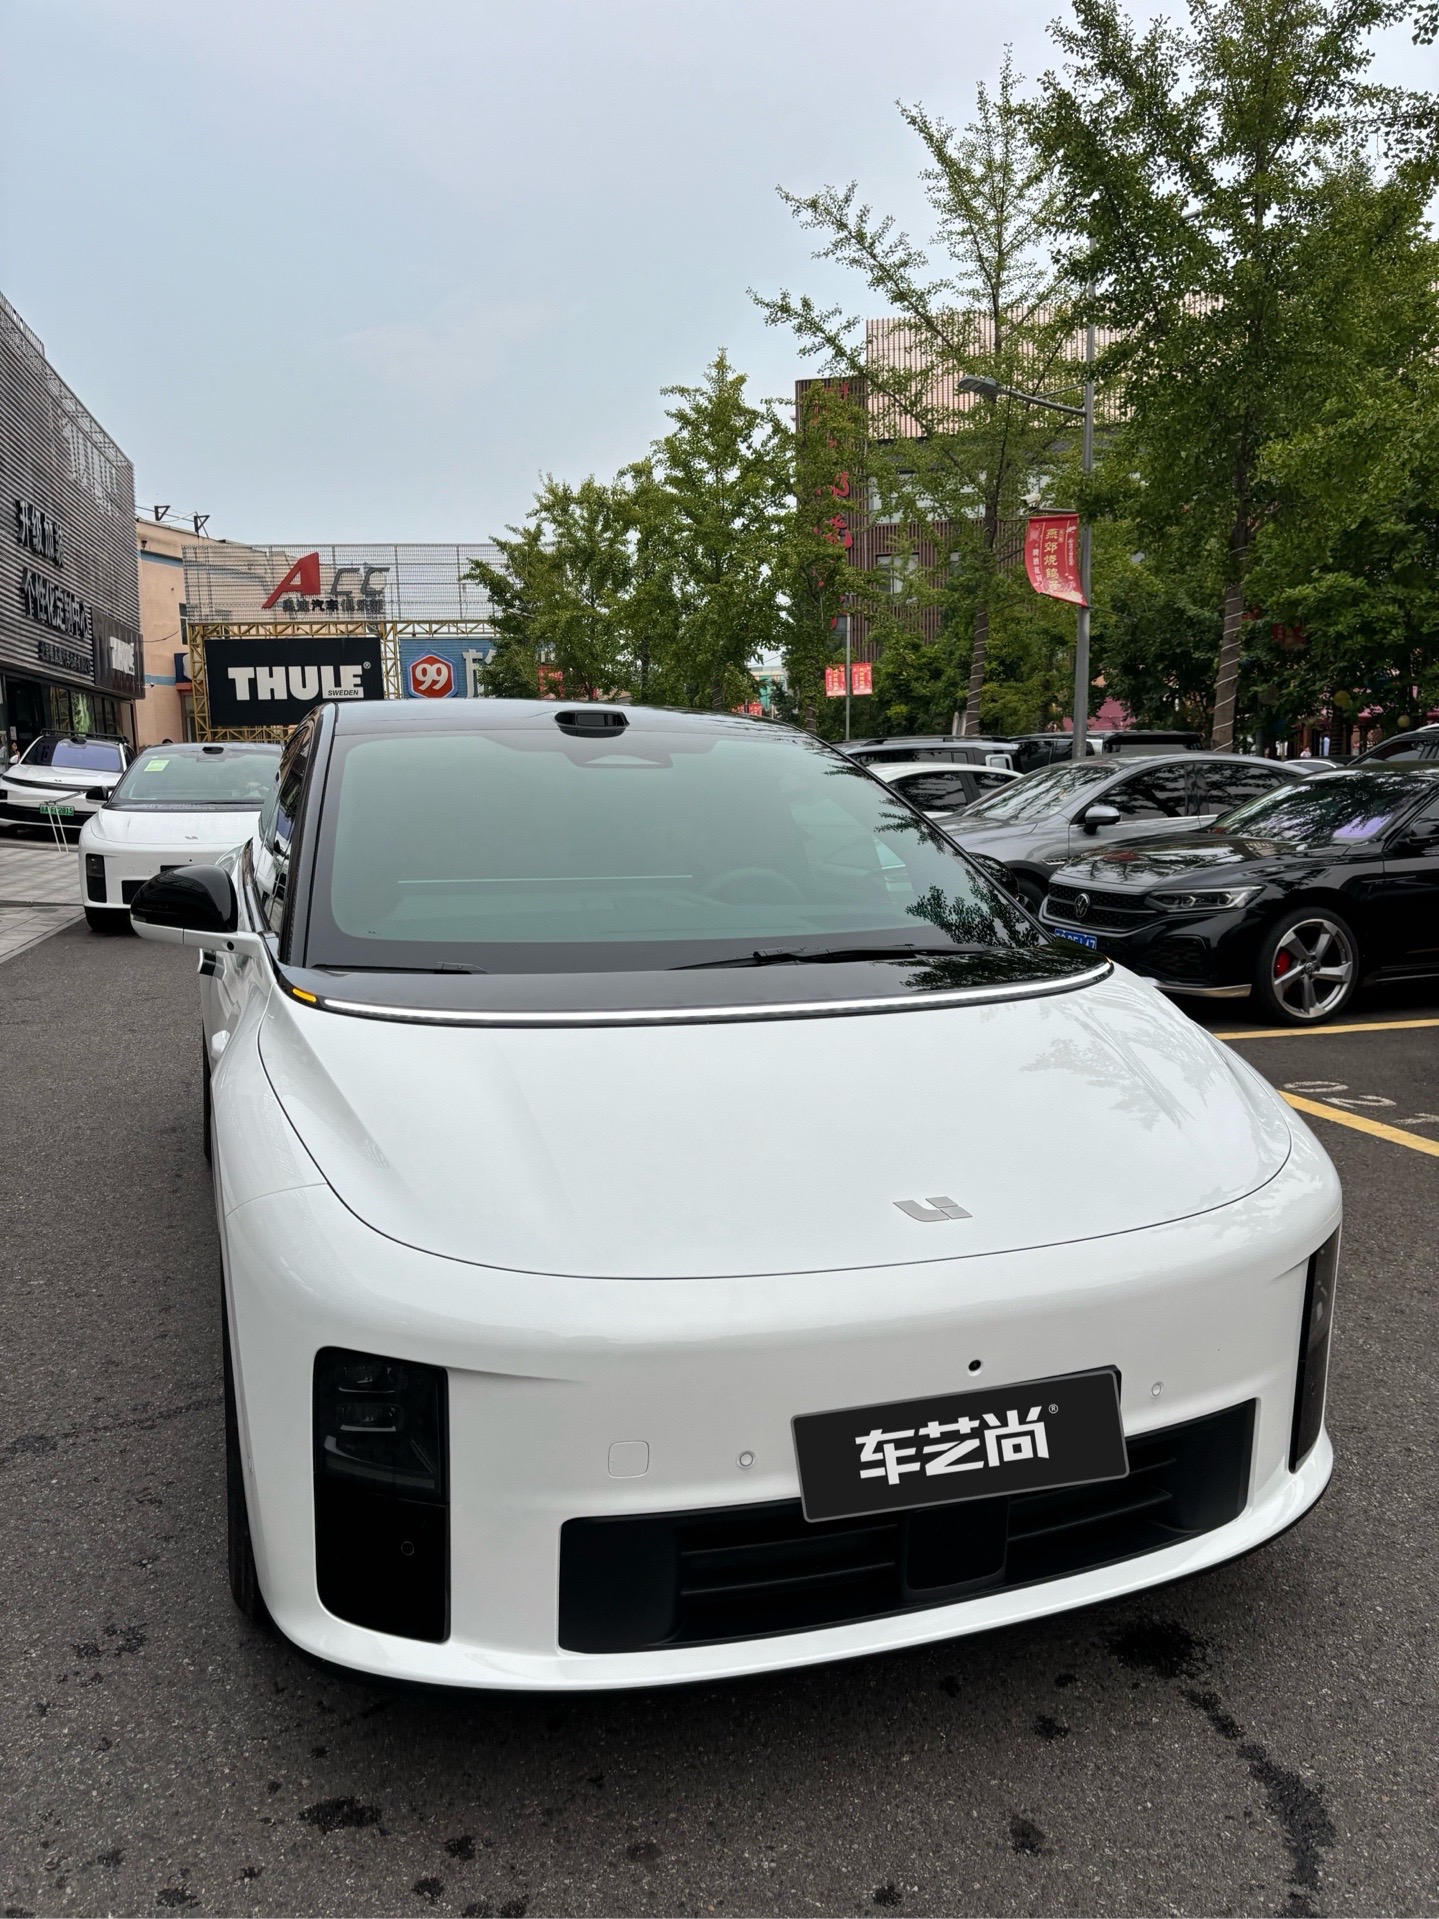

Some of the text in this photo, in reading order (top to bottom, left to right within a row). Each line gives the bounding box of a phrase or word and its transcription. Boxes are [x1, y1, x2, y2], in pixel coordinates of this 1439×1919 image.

[415, 663, 449, 691] 99
[327, 689, 360, 697] SWEDEN
[855, 1405, 1050, 1486] 车艺尚
